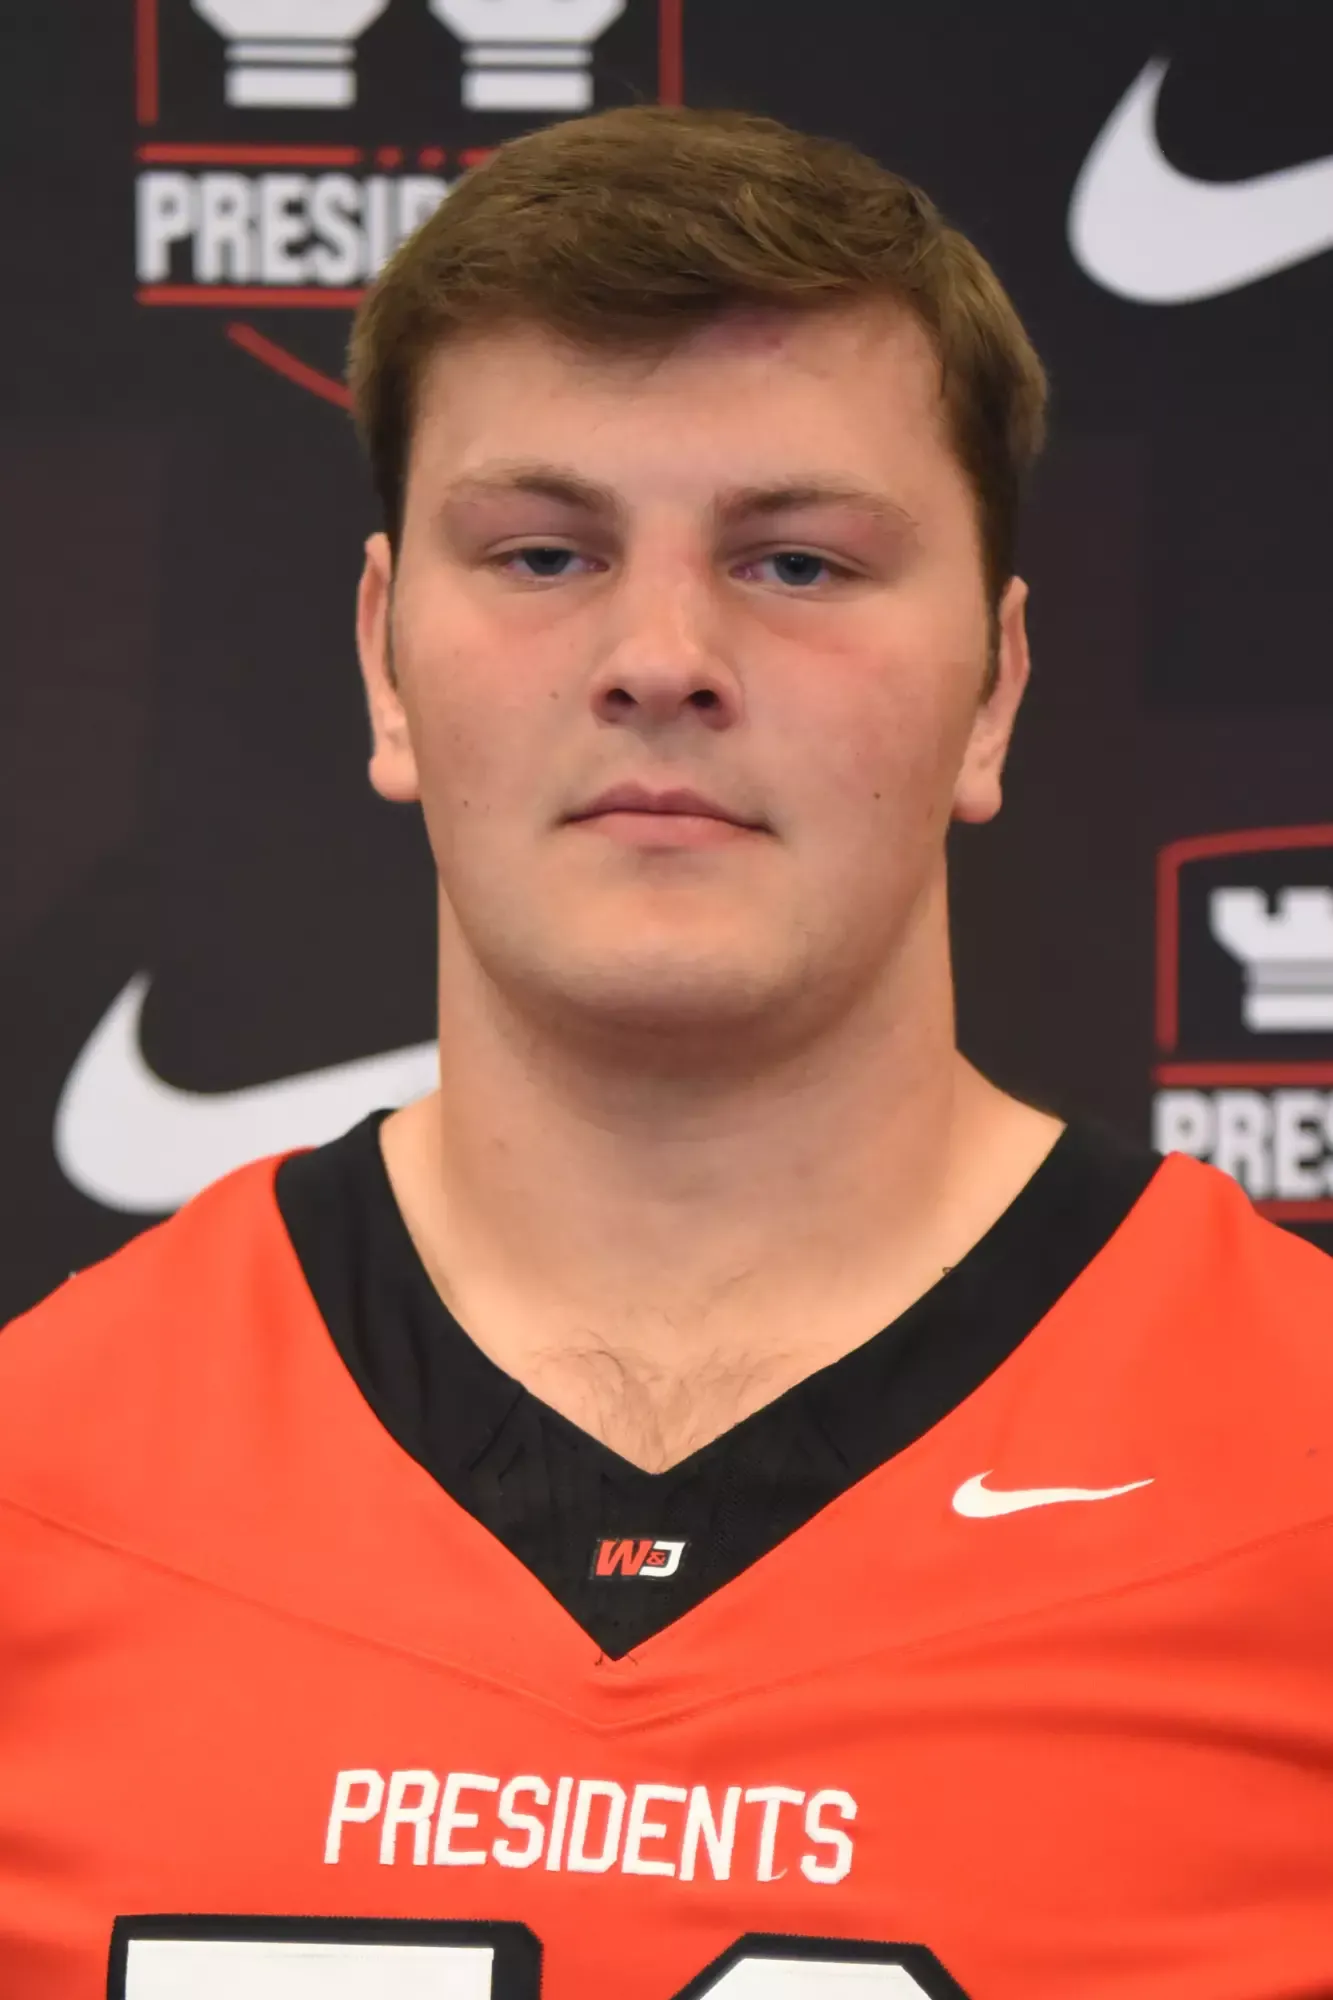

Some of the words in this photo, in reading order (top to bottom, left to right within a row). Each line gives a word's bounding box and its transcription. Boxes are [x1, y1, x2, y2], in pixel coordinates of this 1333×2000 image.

[1153, 1088, 1333, 1199] PRE
[595, 1539, 686, 1577] W&J
[324, 1769, 858, 1884] PRESIDENTS
